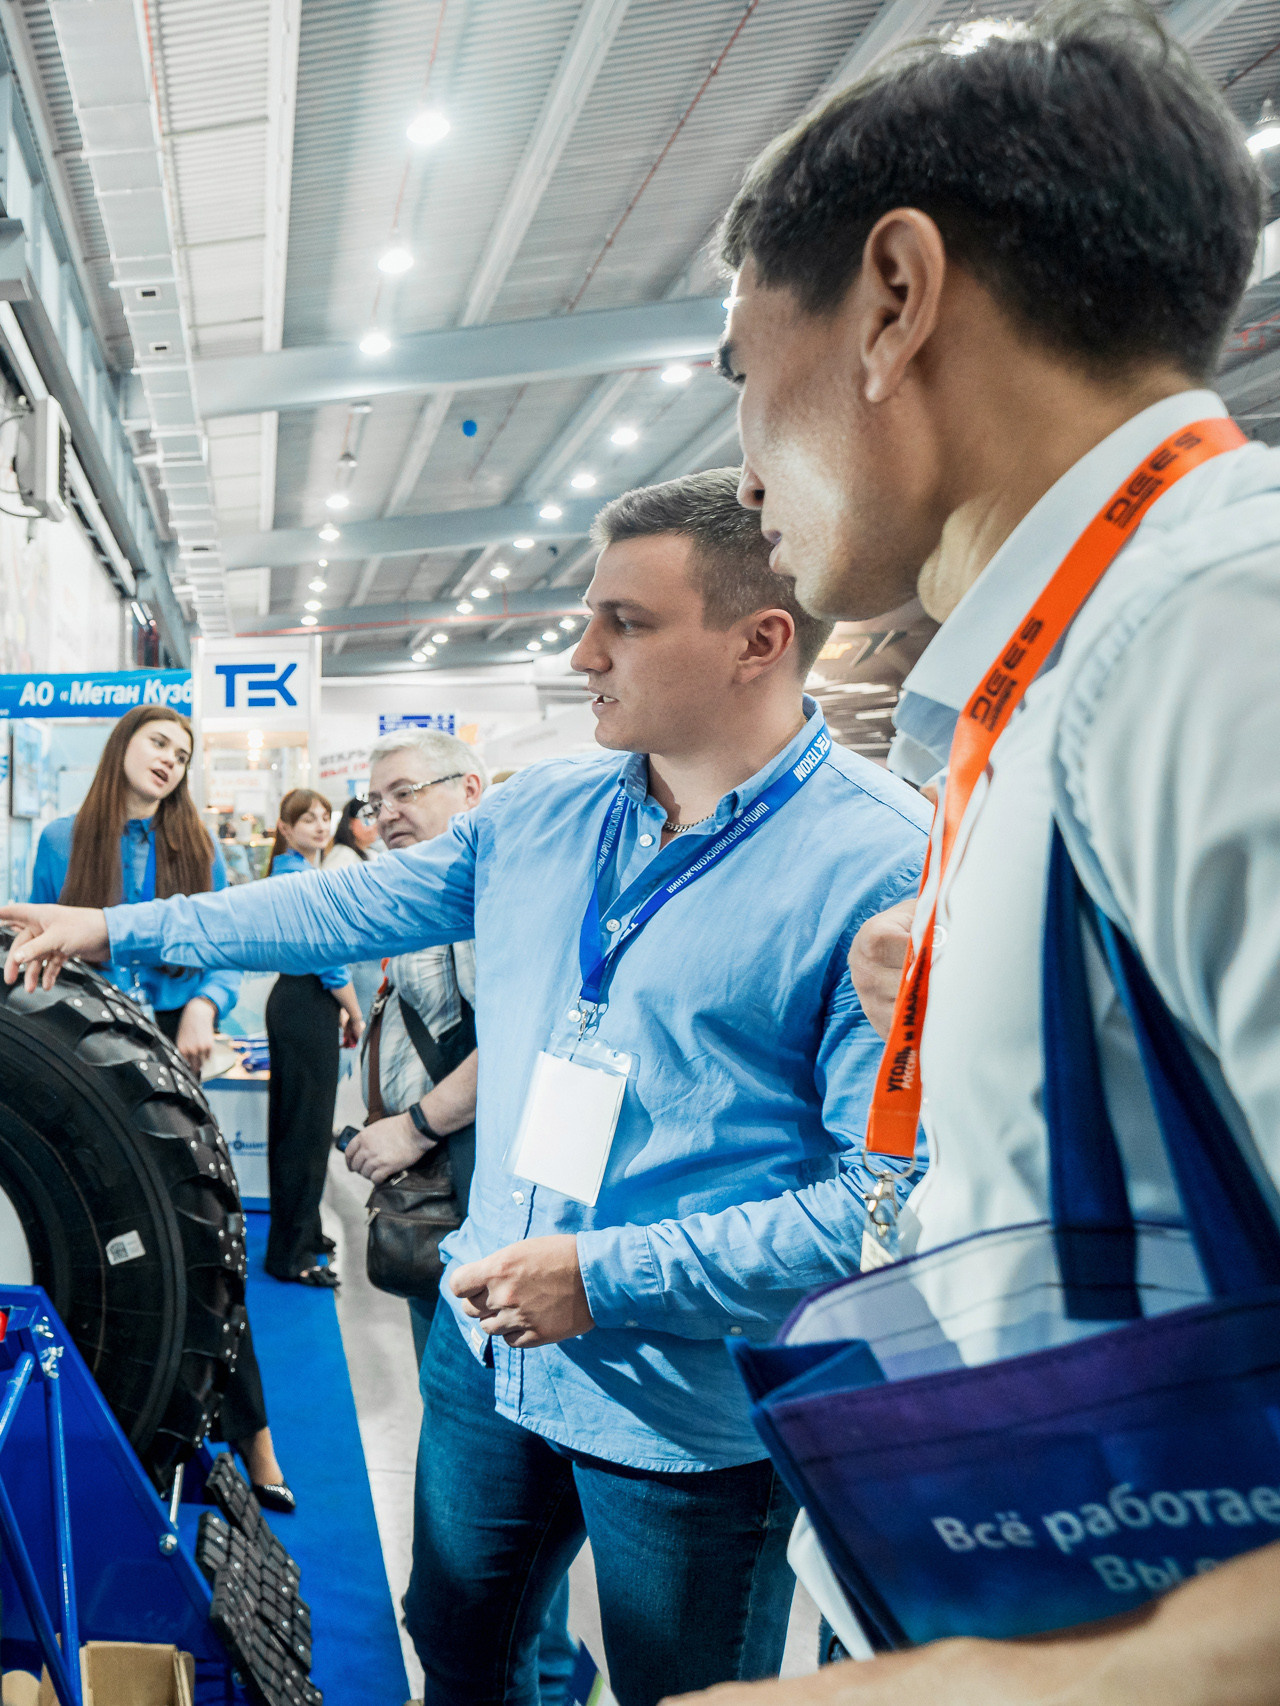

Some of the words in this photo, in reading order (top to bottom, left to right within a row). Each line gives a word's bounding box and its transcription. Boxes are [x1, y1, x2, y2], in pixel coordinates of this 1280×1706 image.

[19, 681, 55, 707] АО
[60, 680, 140, 705] «Метан
[215, 663, 298, 707] TEK
[793, 747, 823, 782] TEKOM
[743, 801, 770, 827] ШИПЫ
[666, 821, 747, 894] ПРОТИВОСКОЛЬЖЕНИЯ
[887, 1045, 911, 1093] УГОЛЬ
[901, 1049, 918, 1090] РОССИИ
[931, 1509, 1036, 1552] Всё
[1042, 1482, 1280, 1555] работае
[1091, 1554, 1186, 1592] Вы
